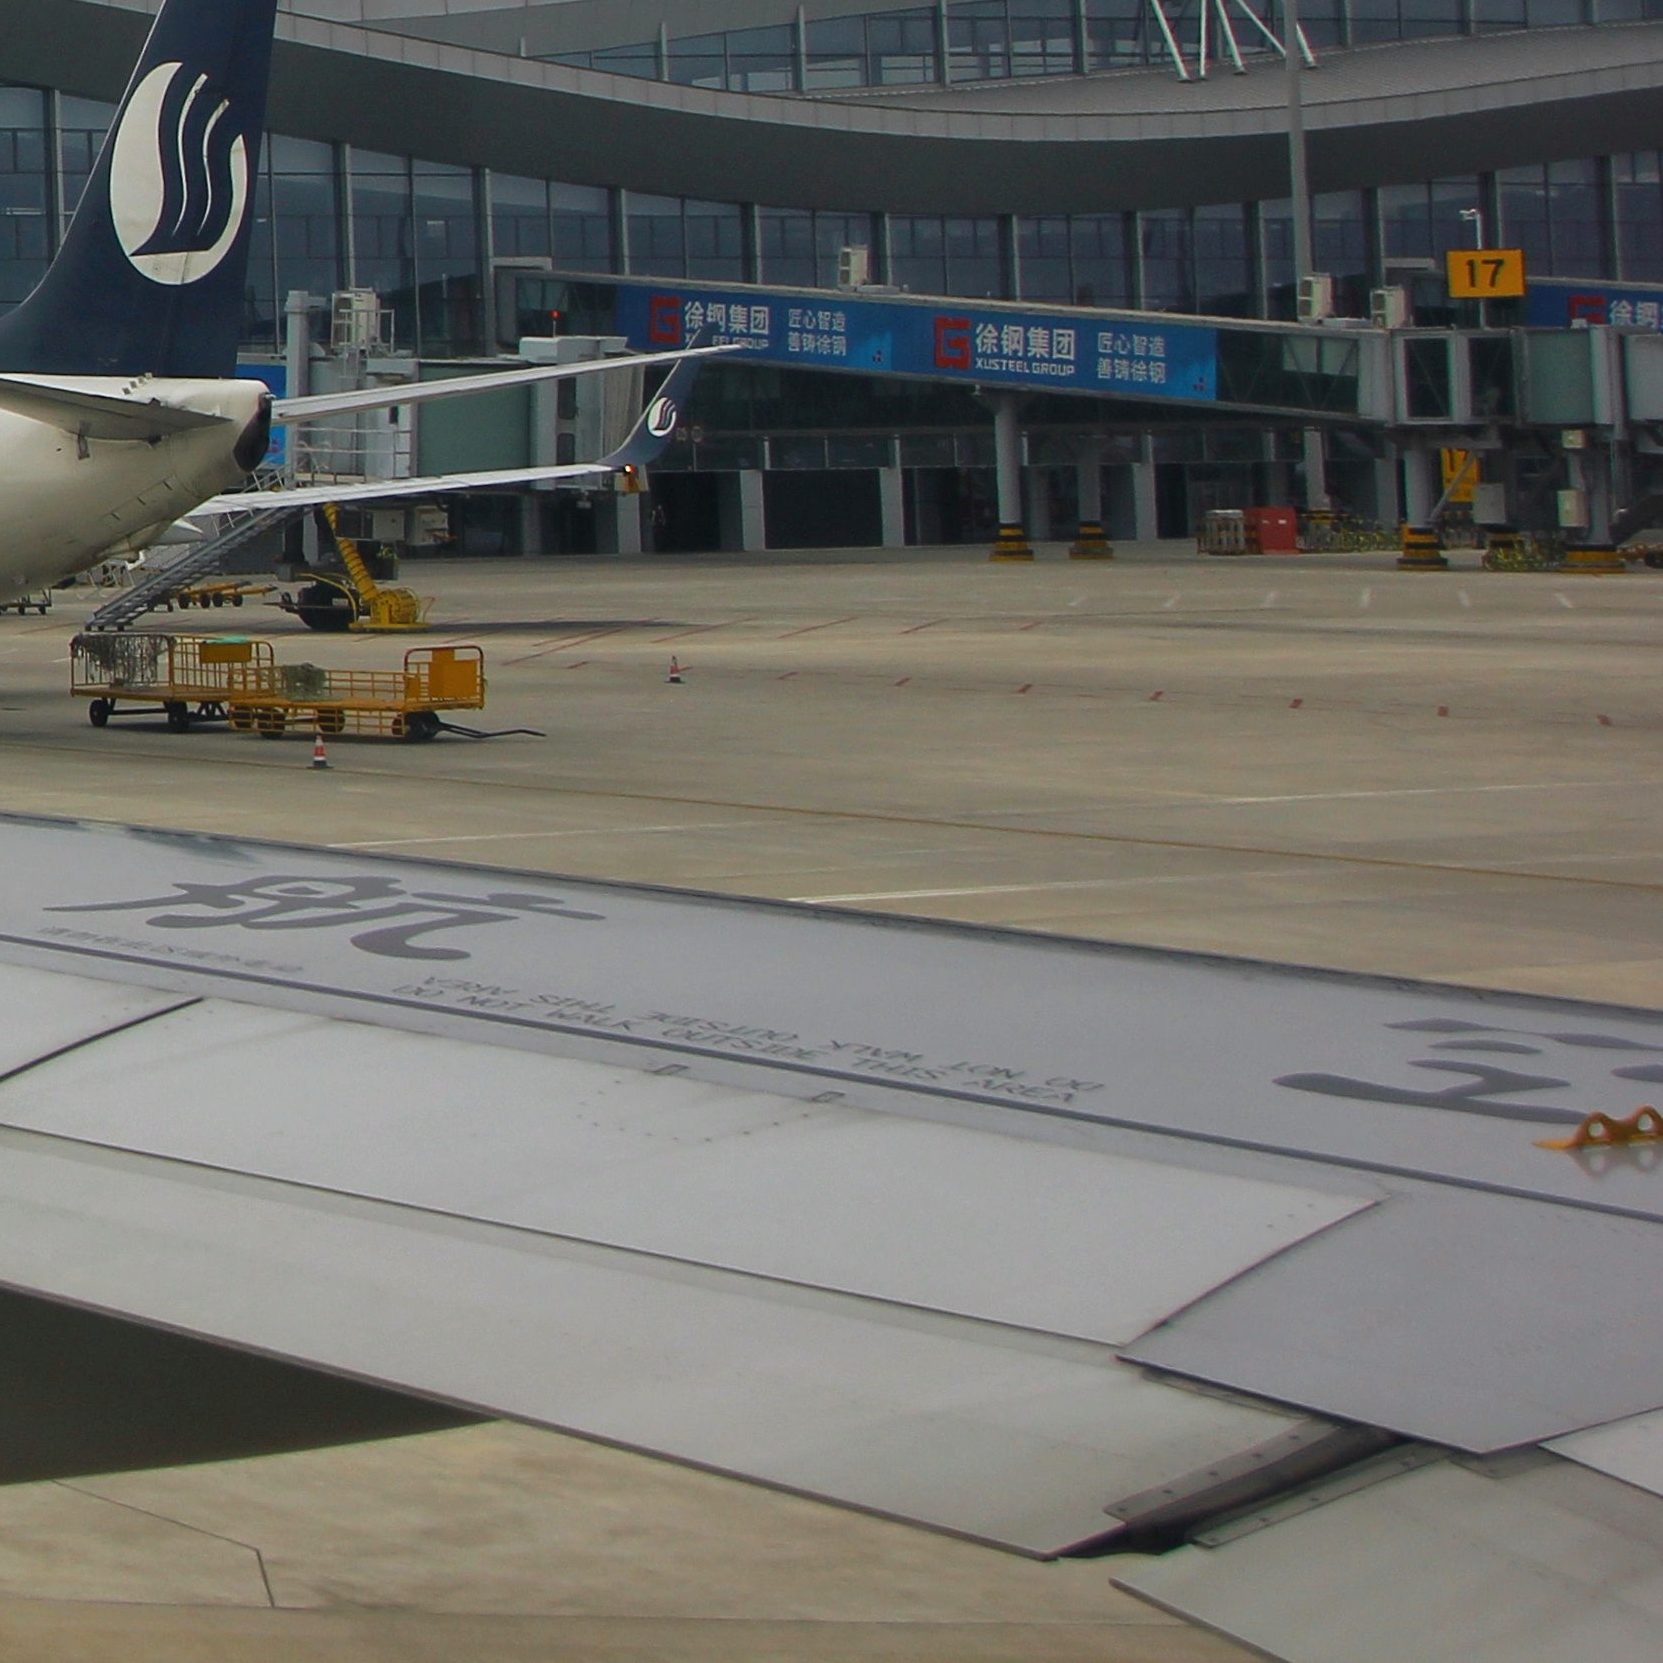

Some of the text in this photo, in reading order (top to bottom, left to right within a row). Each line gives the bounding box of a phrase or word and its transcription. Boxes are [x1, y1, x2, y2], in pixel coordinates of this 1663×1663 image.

[1466, 258, 1505, 288] 17
[684, 301, 770, 335] 徐钢集团
[788, 308, 846, 333] 匠心智造
[975, 323, 1075, 361] 徐钢集团
[1097, 332, 1166, 358] 匠心智造
[975, 358, 1075, 376] XUSTEEL GROUP
[530, 992, 616, 1015] THIS
[458, 995, 534, 1012] NOT
[545, 1008, 644, 1032] WALK
[660, 1027, 828, 1060] OUTSIDE
[850, 1056, 948, 1081] THIS
[636, 1010, 800, 1041] OUTSIDE
[820, 1038, 923, 1063] WALK
[940, 1060, 1026, 1080] NOT
